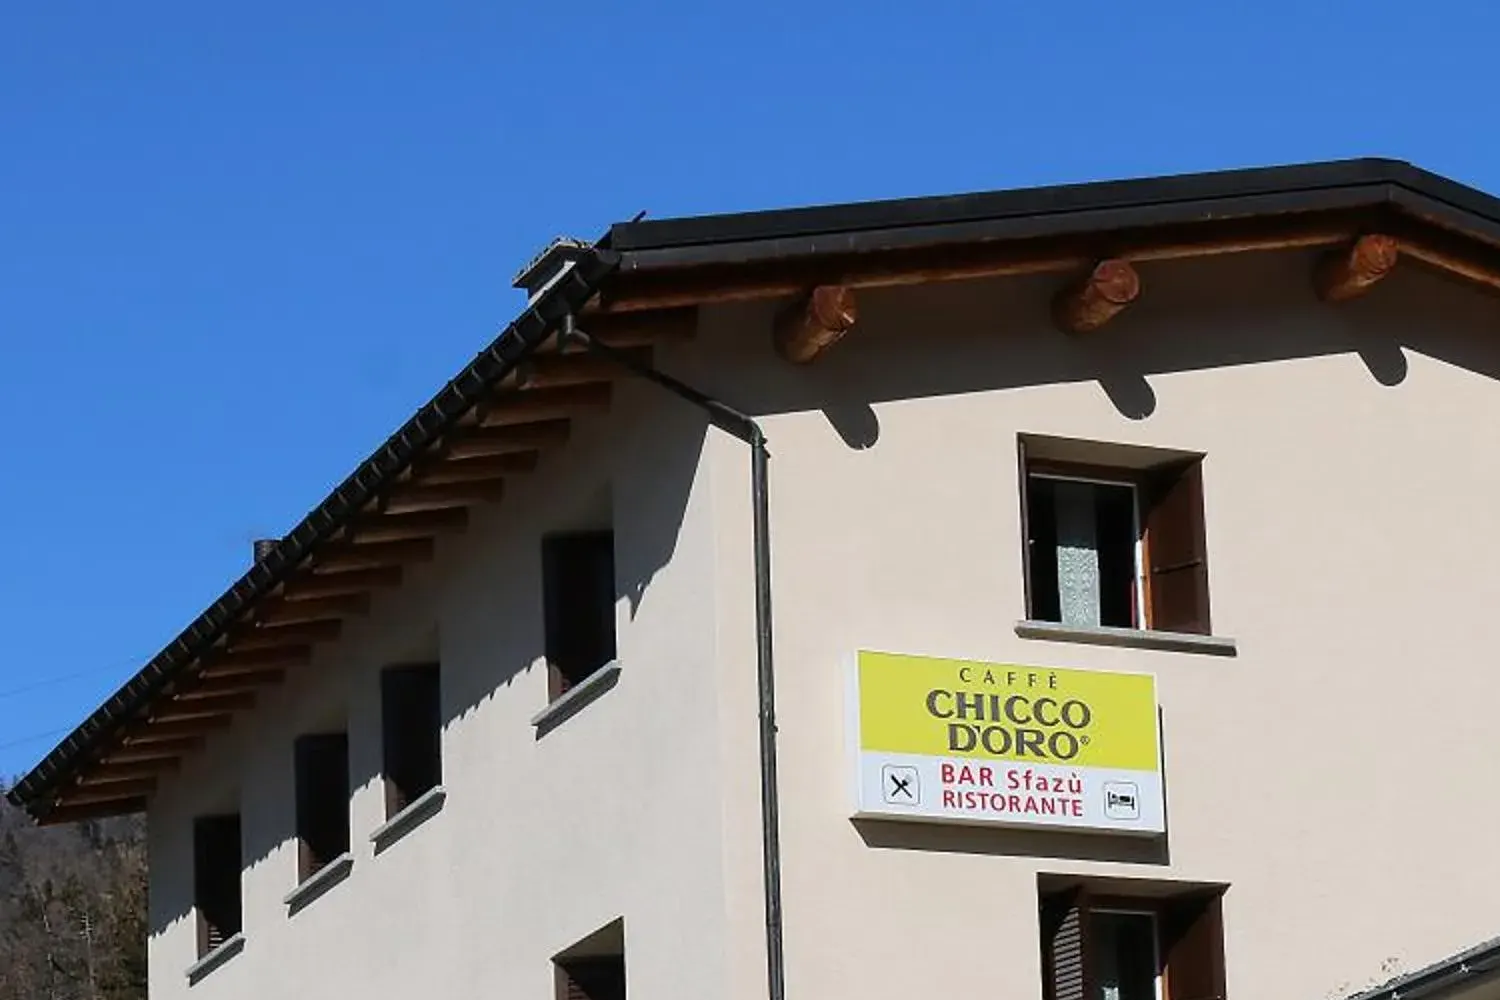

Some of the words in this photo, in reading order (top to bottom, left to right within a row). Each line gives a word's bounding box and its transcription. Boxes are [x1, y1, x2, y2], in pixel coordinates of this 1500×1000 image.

[959, 667, 1058, 690] CAFFÈ
[926, 689, 1092, 729] CHICCO
[941, 763, 994, 787] BAR
[1007, 769, 1083, 794] Sfazù
[942, 790, 1084, 817] RISTORANTE
